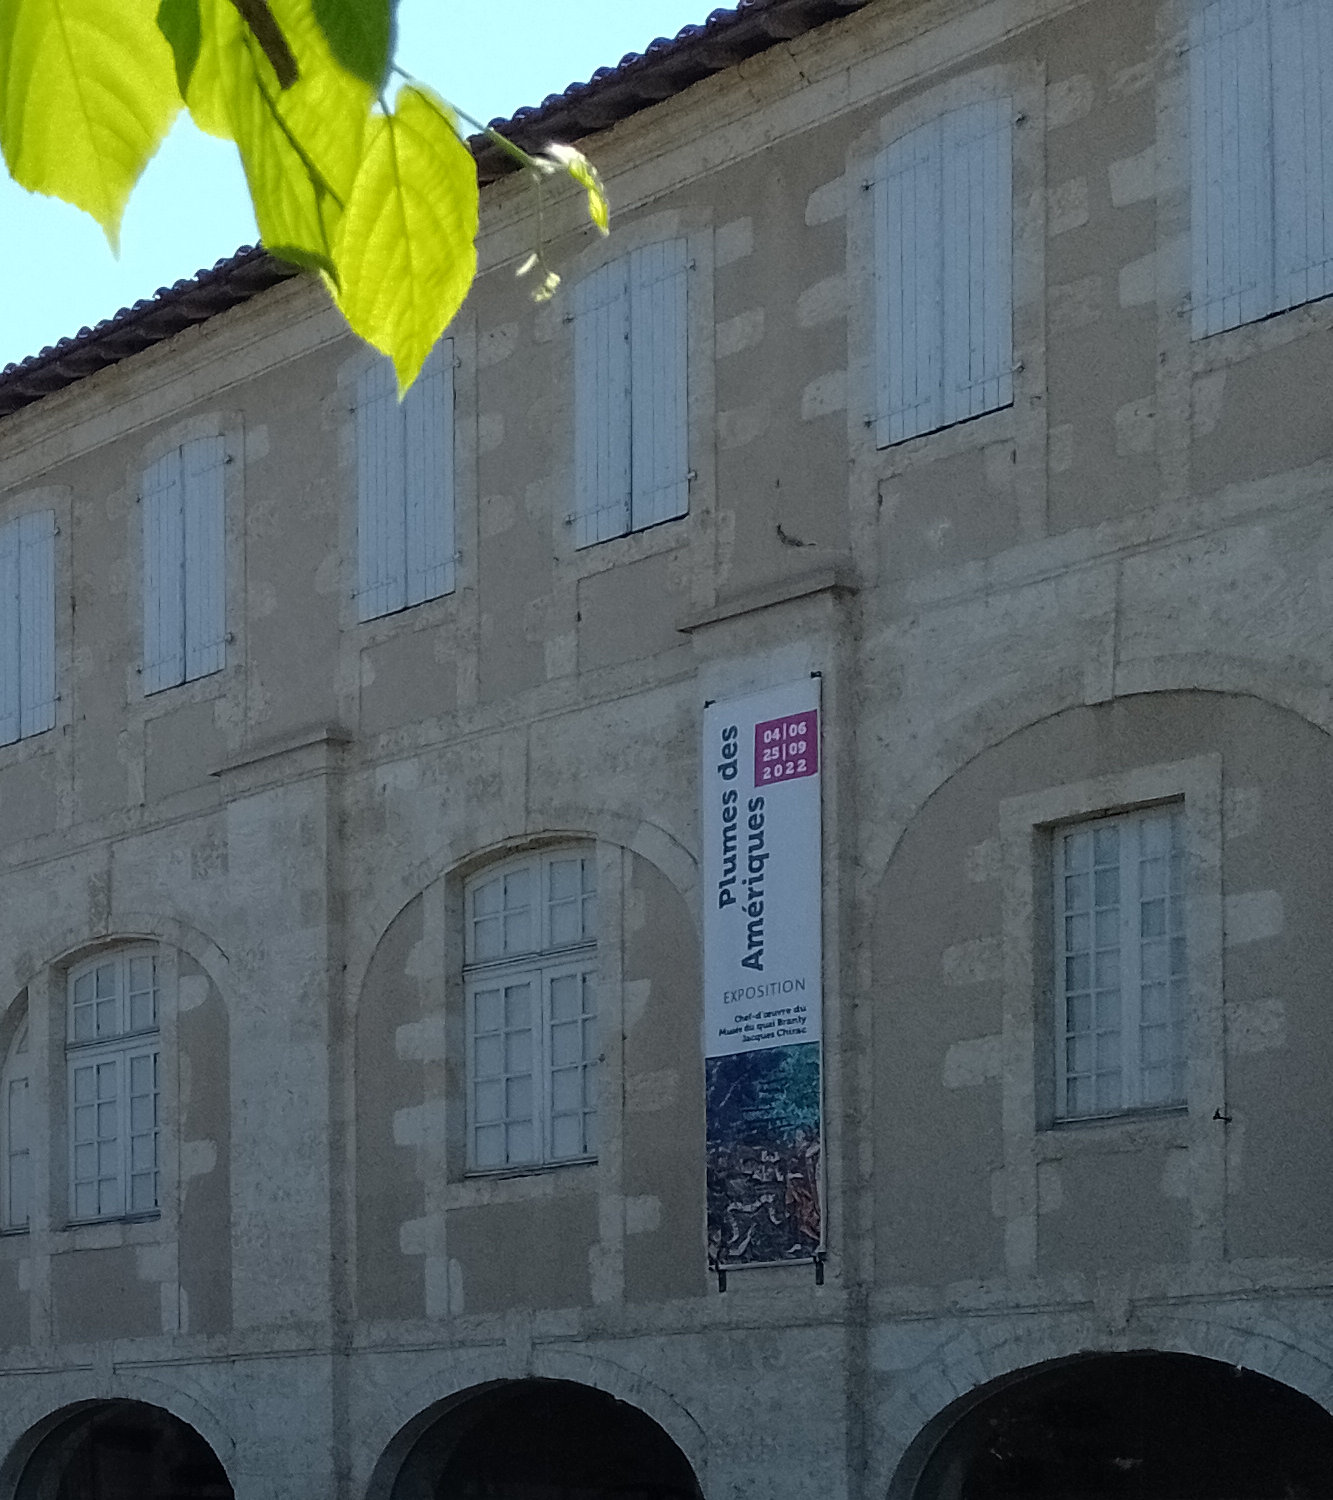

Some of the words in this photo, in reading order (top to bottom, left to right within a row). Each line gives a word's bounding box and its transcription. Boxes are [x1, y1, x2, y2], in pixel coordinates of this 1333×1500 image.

[717, 724, 739, 781] des
[763, 759, 807, 780] 2022
[718, 789, 739, 909] Plumes
[741, 796, 770, 972] Amériques
[723, 978, 806, 1004] EXPOSITION
[793, 1005, 807, 1013] du
[742, 1033, 775, 1042] Jacques
[776, 1027, 807, 1038] Chirac
[744, 1023, 755, 1032] du
[756, 1020, 775, 1031] quai
[777, 1015, 807, 1026] Branly
